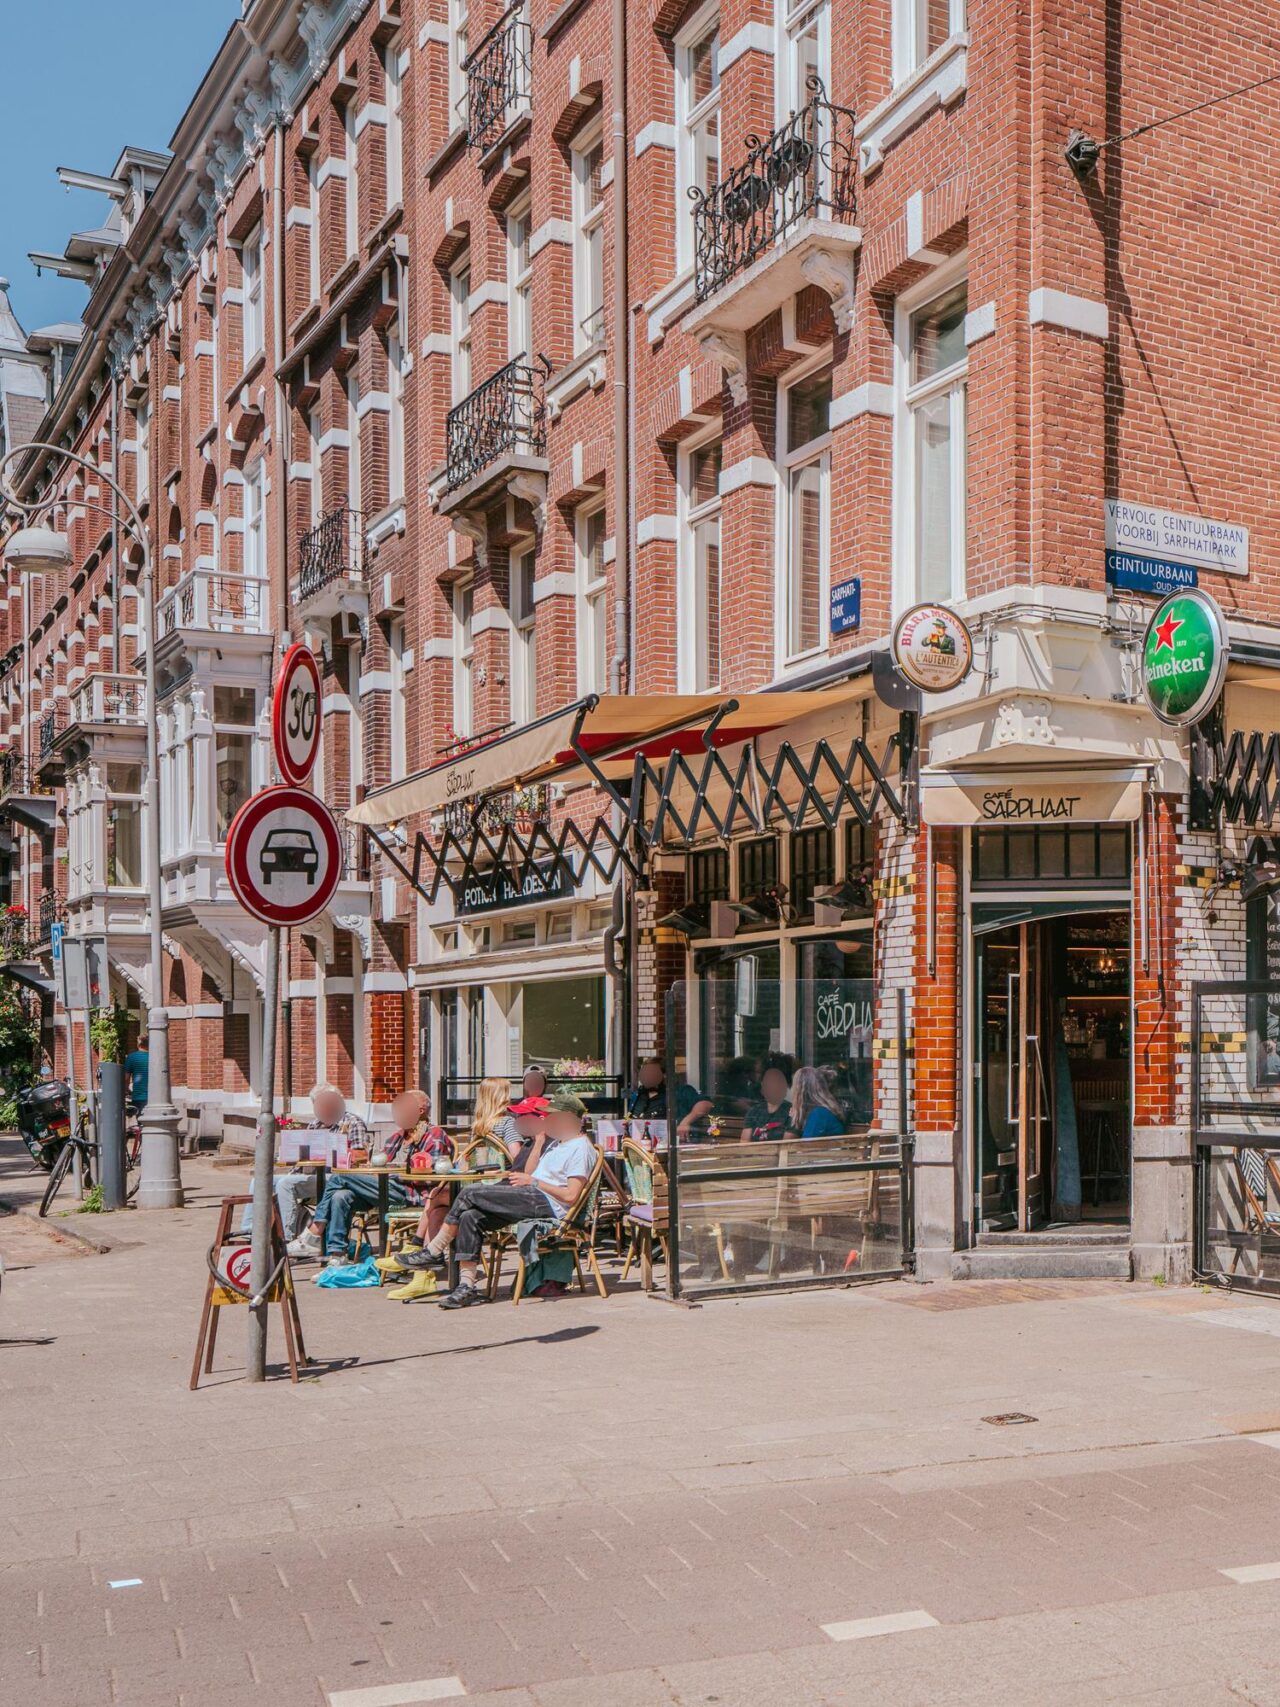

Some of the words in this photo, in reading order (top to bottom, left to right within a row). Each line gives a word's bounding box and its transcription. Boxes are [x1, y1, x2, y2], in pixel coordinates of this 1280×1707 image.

[1109, 504, 1156, 526] VERVOLG
[1162, 516, 1243, 543] CEINTUURBAAN
[1116, 523, 1159, 546] VOORBIJ
[1164, 533, 1236, 558] SARPHATIPARK
[1108, 556, 1193, 583] CEINTUURBAAN
[831, 604, 844, 620] PARK
[901, 611, 930, 647] BIRRA
[288, 686, 317, 741] 30
[984, 788, 1013, 799] CAFÉ
[983, 797, 1081, 819] SARPHAAT
[817, 987, 840, 1006] CAFÉ
